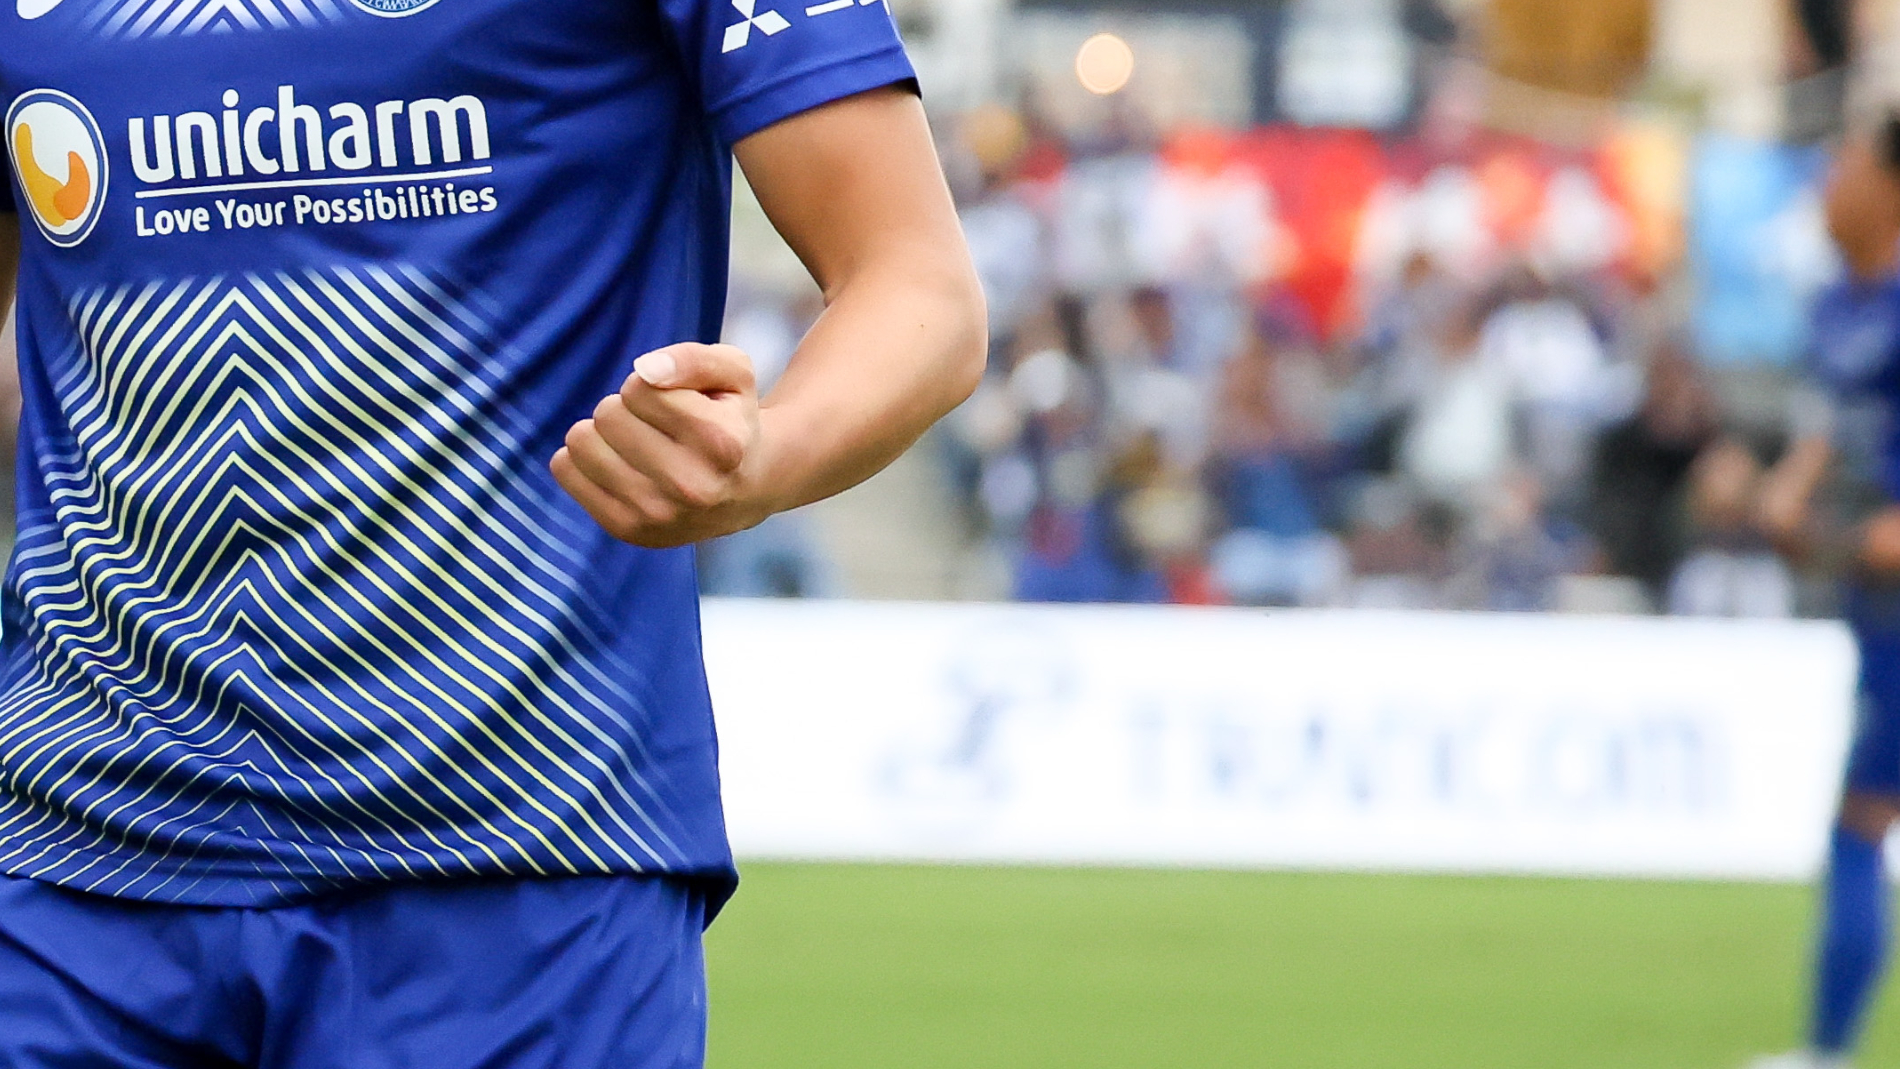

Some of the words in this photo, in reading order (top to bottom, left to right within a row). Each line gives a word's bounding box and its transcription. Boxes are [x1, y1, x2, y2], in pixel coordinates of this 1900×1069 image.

[127, 84, 491, 184] unicharm
[135, 206, 210, 237] Love
[215, 198, 286, 230] Your
[293, 183, 498, 226] Possibilities
